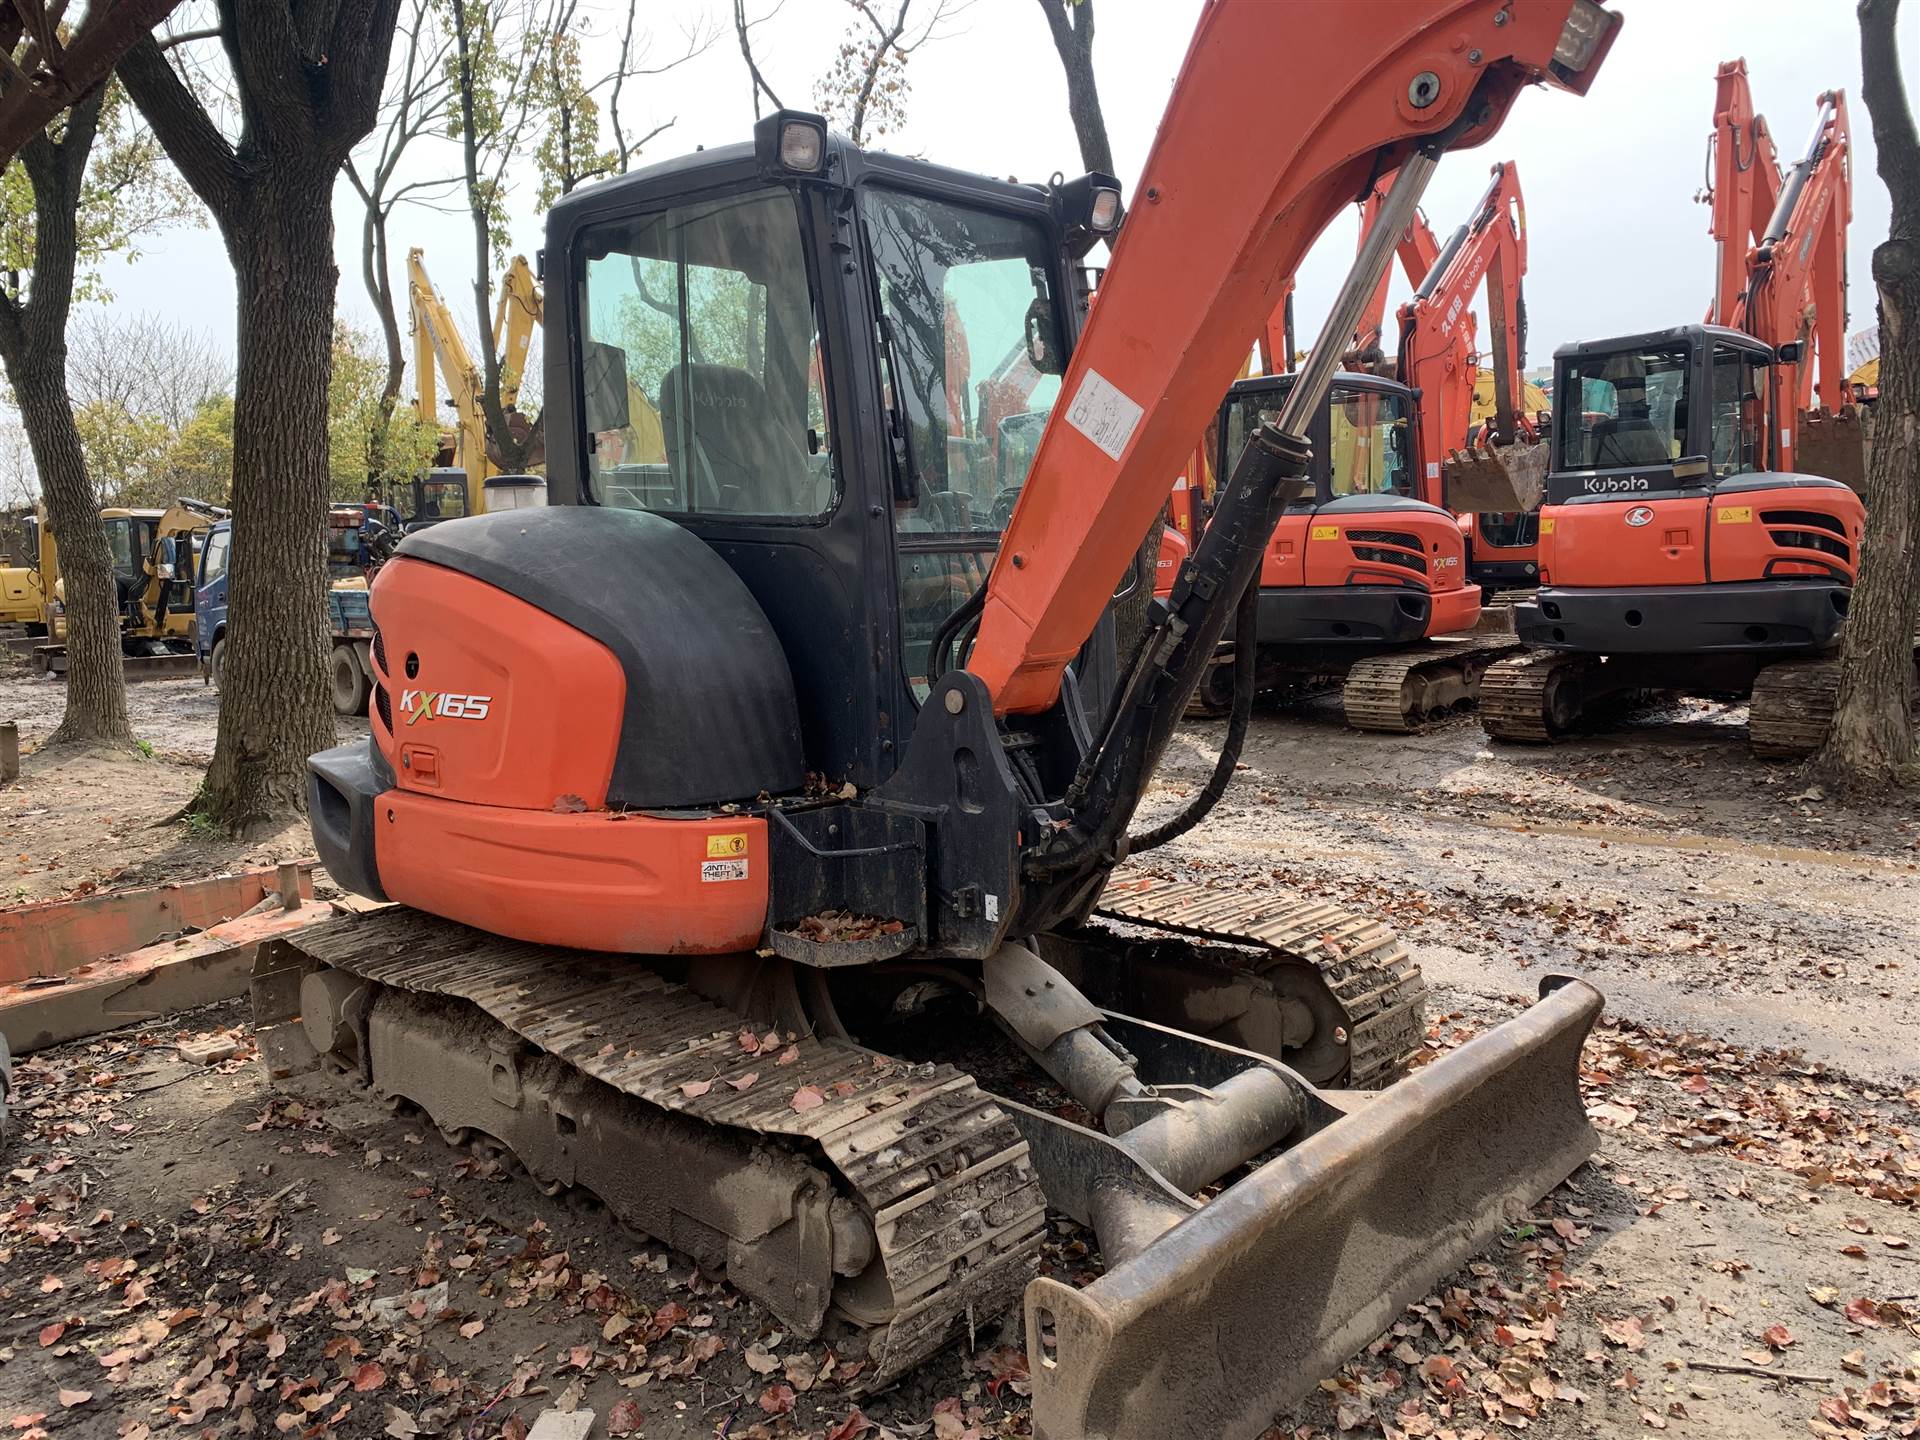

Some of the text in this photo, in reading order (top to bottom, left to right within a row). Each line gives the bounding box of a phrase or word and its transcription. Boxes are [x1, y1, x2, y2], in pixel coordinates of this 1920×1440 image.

[1463, 255, 1483, 291] Kubota
[1441, 294, 1463, 337] 久保田
[1584, 475, 1649, 493] Kubota
[1433, 556, 1458, 571] KX165
[400, 689, 493, 726] KX165
[703, 870, 731, 879] THEFT
